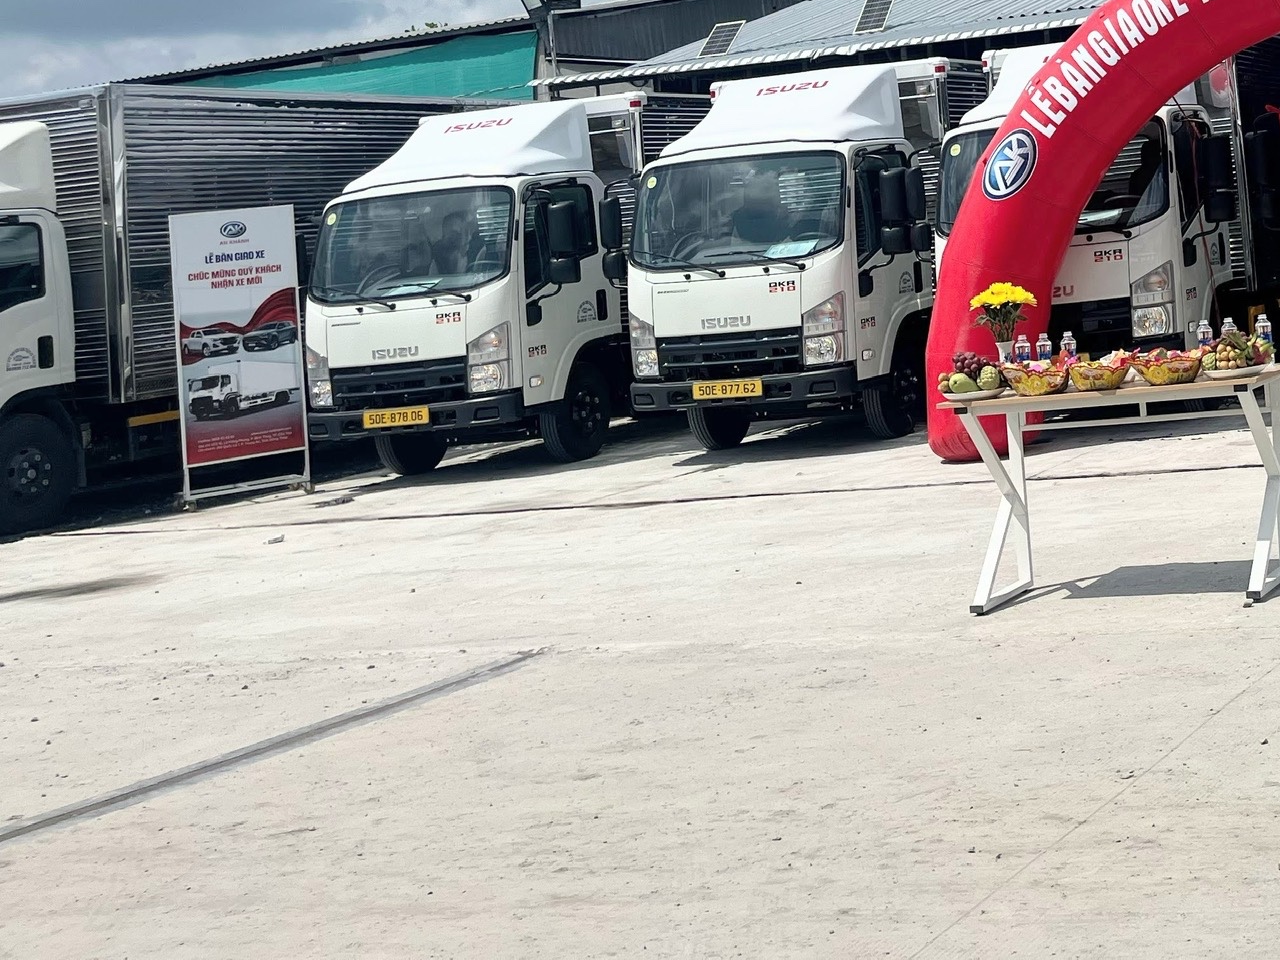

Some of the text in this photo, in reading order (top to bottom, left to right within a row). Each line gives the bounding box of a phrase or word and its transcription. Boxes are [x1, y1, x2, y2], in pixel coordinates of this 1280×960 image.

[756, 81, 829, 96] ISUZU
[444, 117, 513, 134] ISUZU
[255, 249, 265, 259] XE
[1093, 249, 1123, 257] QKR
[1094, 254, 1123, 263] 210
[235, 277, 245, 286] XE
[769, 285, 796, 293] 210
[436, 311, 461, 319] QKR
[436, 316, 461, 324] 210
[701, 315, 751, 330] ISUZU
[371, 345, 419, 360] ISUZU
[698, 383, 756, 396] 50E-877.62
[369, 410, 423, 425] 50E-878.06
